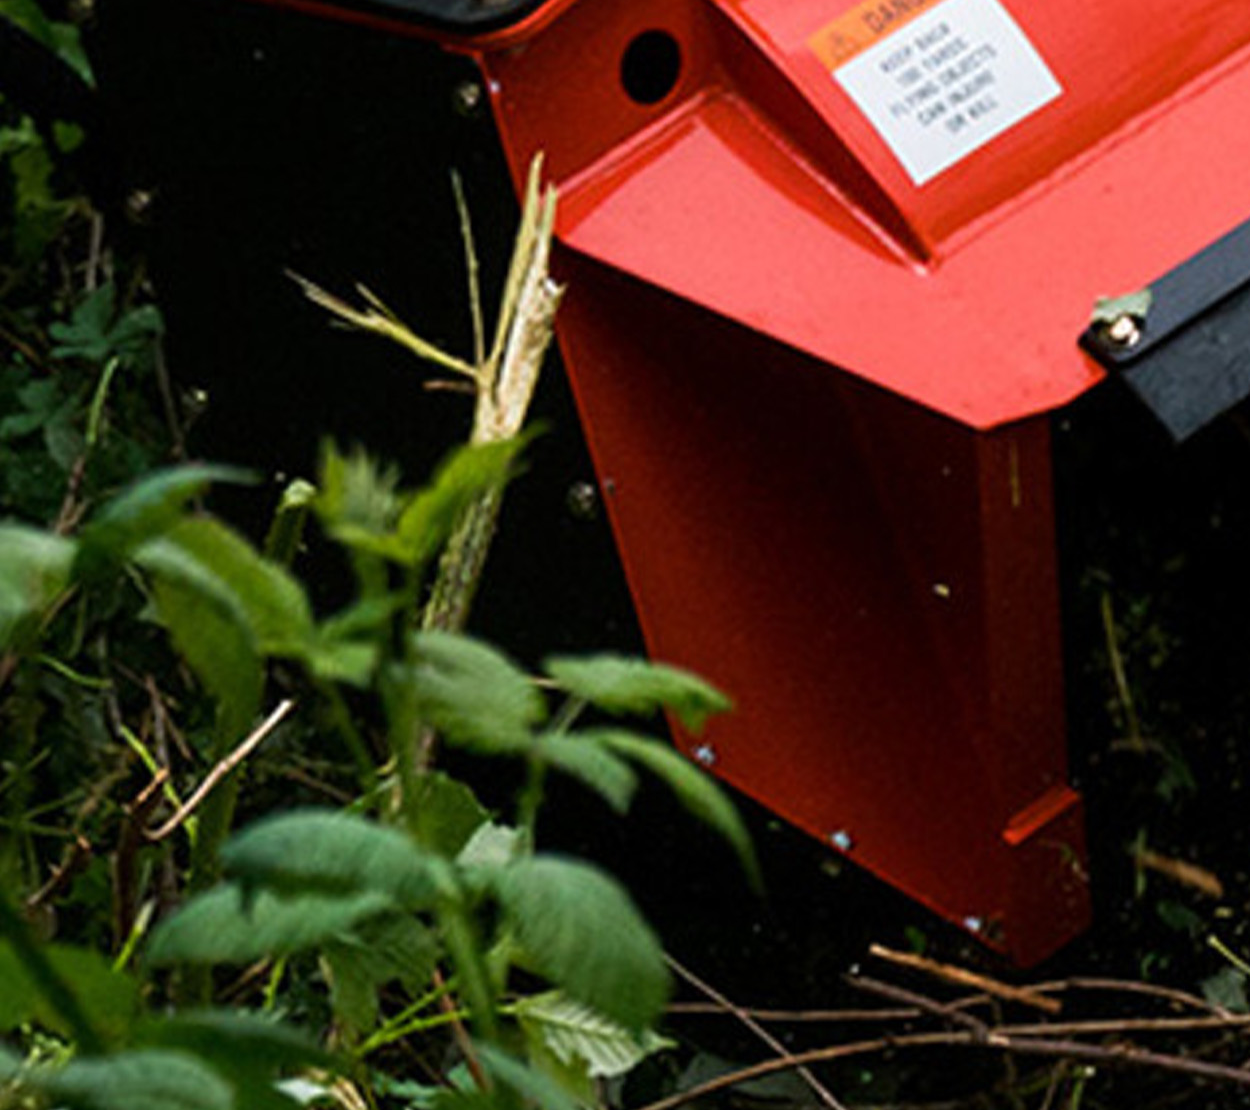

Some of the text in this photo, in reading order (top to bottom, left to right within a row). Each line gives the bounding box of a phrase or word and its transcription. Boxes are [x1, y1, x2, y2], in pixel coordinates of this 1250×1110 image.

[879, 23, 949, 72] KEEP BACK
[890, 44, 996, 117] FLYING OBJECTS
[916, 70, 995, 126] CAN INJURE
[945, 95, 996, 133] OR KILL
